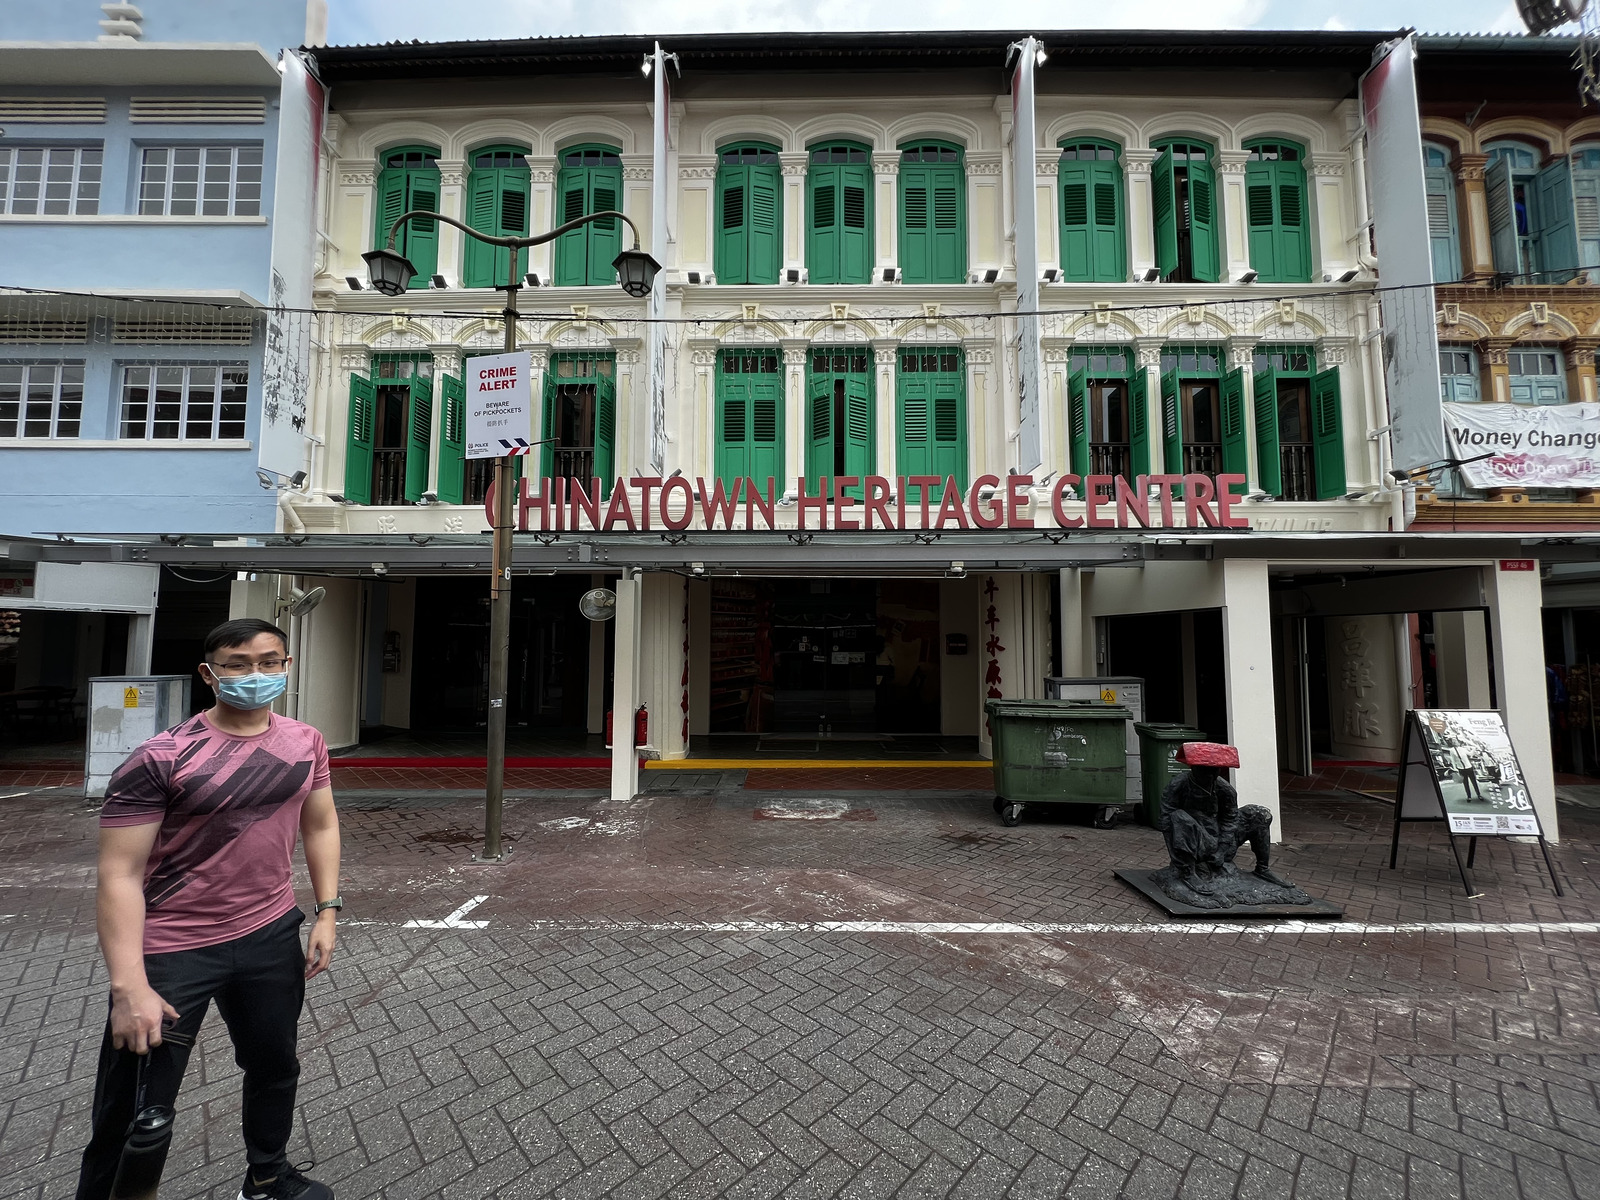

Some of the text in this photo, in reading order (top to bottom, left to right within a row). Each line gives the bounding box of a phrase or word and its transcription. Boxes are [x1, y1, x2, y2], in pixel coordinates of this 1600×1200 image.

[479, 366, 517, 379] CRIME
[479, 379, 517, 392] ALERT
[482, 407, 522, 416] PICKPOCKETS
[486, 401, 509, 409] BEWARE
[1453, 427, 1600, 450] Money Chang
[798, 474, 1034, 531] HERITAGE
[1050, 473, 1249, 530] CENTRE
[504, 567, 511, 580] 6
